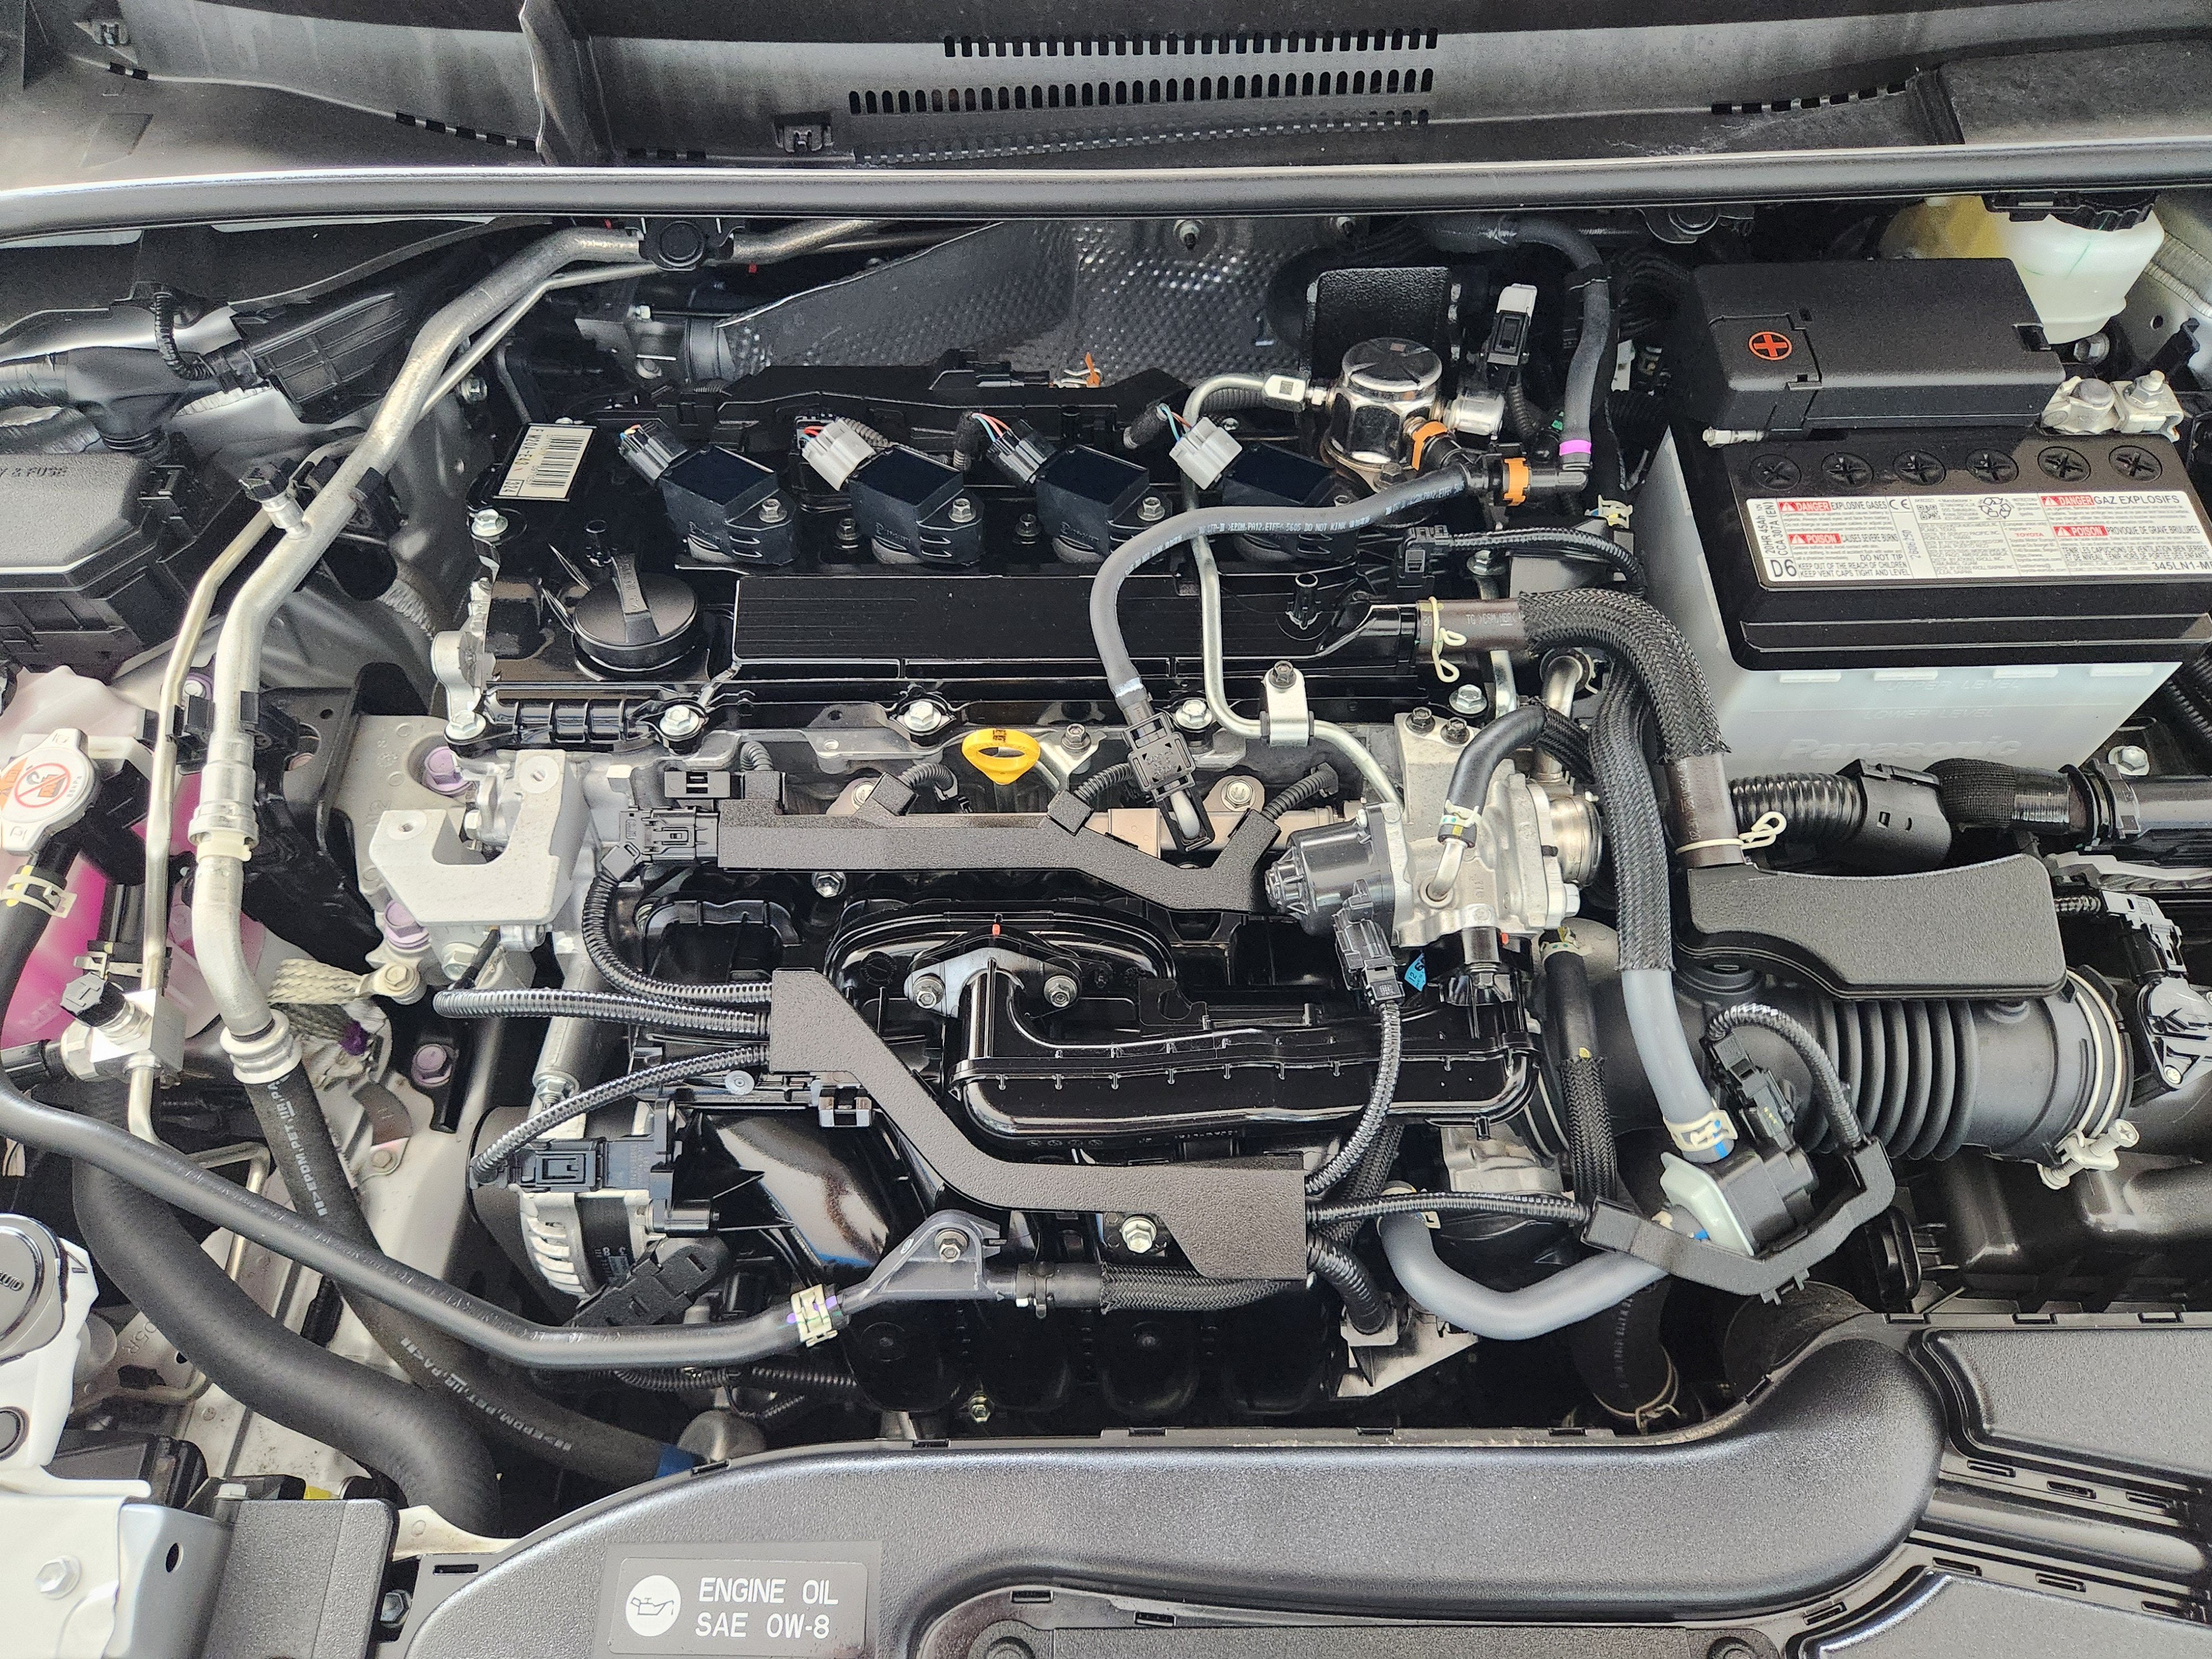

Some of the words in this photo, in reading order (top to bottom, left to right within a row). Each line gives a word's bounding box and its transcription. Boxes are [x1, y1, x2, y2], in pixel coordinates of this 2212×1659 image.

[1796, 502, 1830, 512] DANGER
[1831, 502, 1866, 510] EXPLOSIVE
[1866, 500, 1888, 509] GASES
[2059, 497, 2094, 505] DANGER
[2094, 496, 2119, 504] GAZ
[2120, 495, 2180, 504] EXPLOSIFS
[1764, 502, 1777, 519] (EN)
[1304, 523, 1313, 532] DO
[1315, 523, 1328, 532] NOT
[1757, 515, 1768, 534] 45Ah
[1771, 520, 1783, 538] 307A
[2072, 527, 2103, 536] POISON
[2106, 526, 2138, 535] PROVOQUE
[2141, 526, 2148, 534] DE
[2150, 526, 2168, 534] GRAVE
[1762, 535, 1776, 554] 20HR
[1806, 534, 1840, 544] POISON
[1863, 534, 1881, 542] SEVERE
[1881, 533, 1899, 542] BURNS
[1776, 539, 1788, 556] CCA
[1770, 559, 1797, 578] D6
[1886, 680, 1953, 691] UPPER
[1961, 679, 2020, 690] LEVEL
[1866, 709, 1931, 719] LOWER
[1940, 708, 1994, 718] LEVEL
[1778, 735, 2023, 761] Panasonic
[0, 1269, 24, 1291] LUID
[699, 1577, 786, 1603] ENGINE
[802, 1579, 839, 1605] OIL
[695, 1611, 749, 1637] SAE
[766, 1613, 830, 1639] 0W-8
